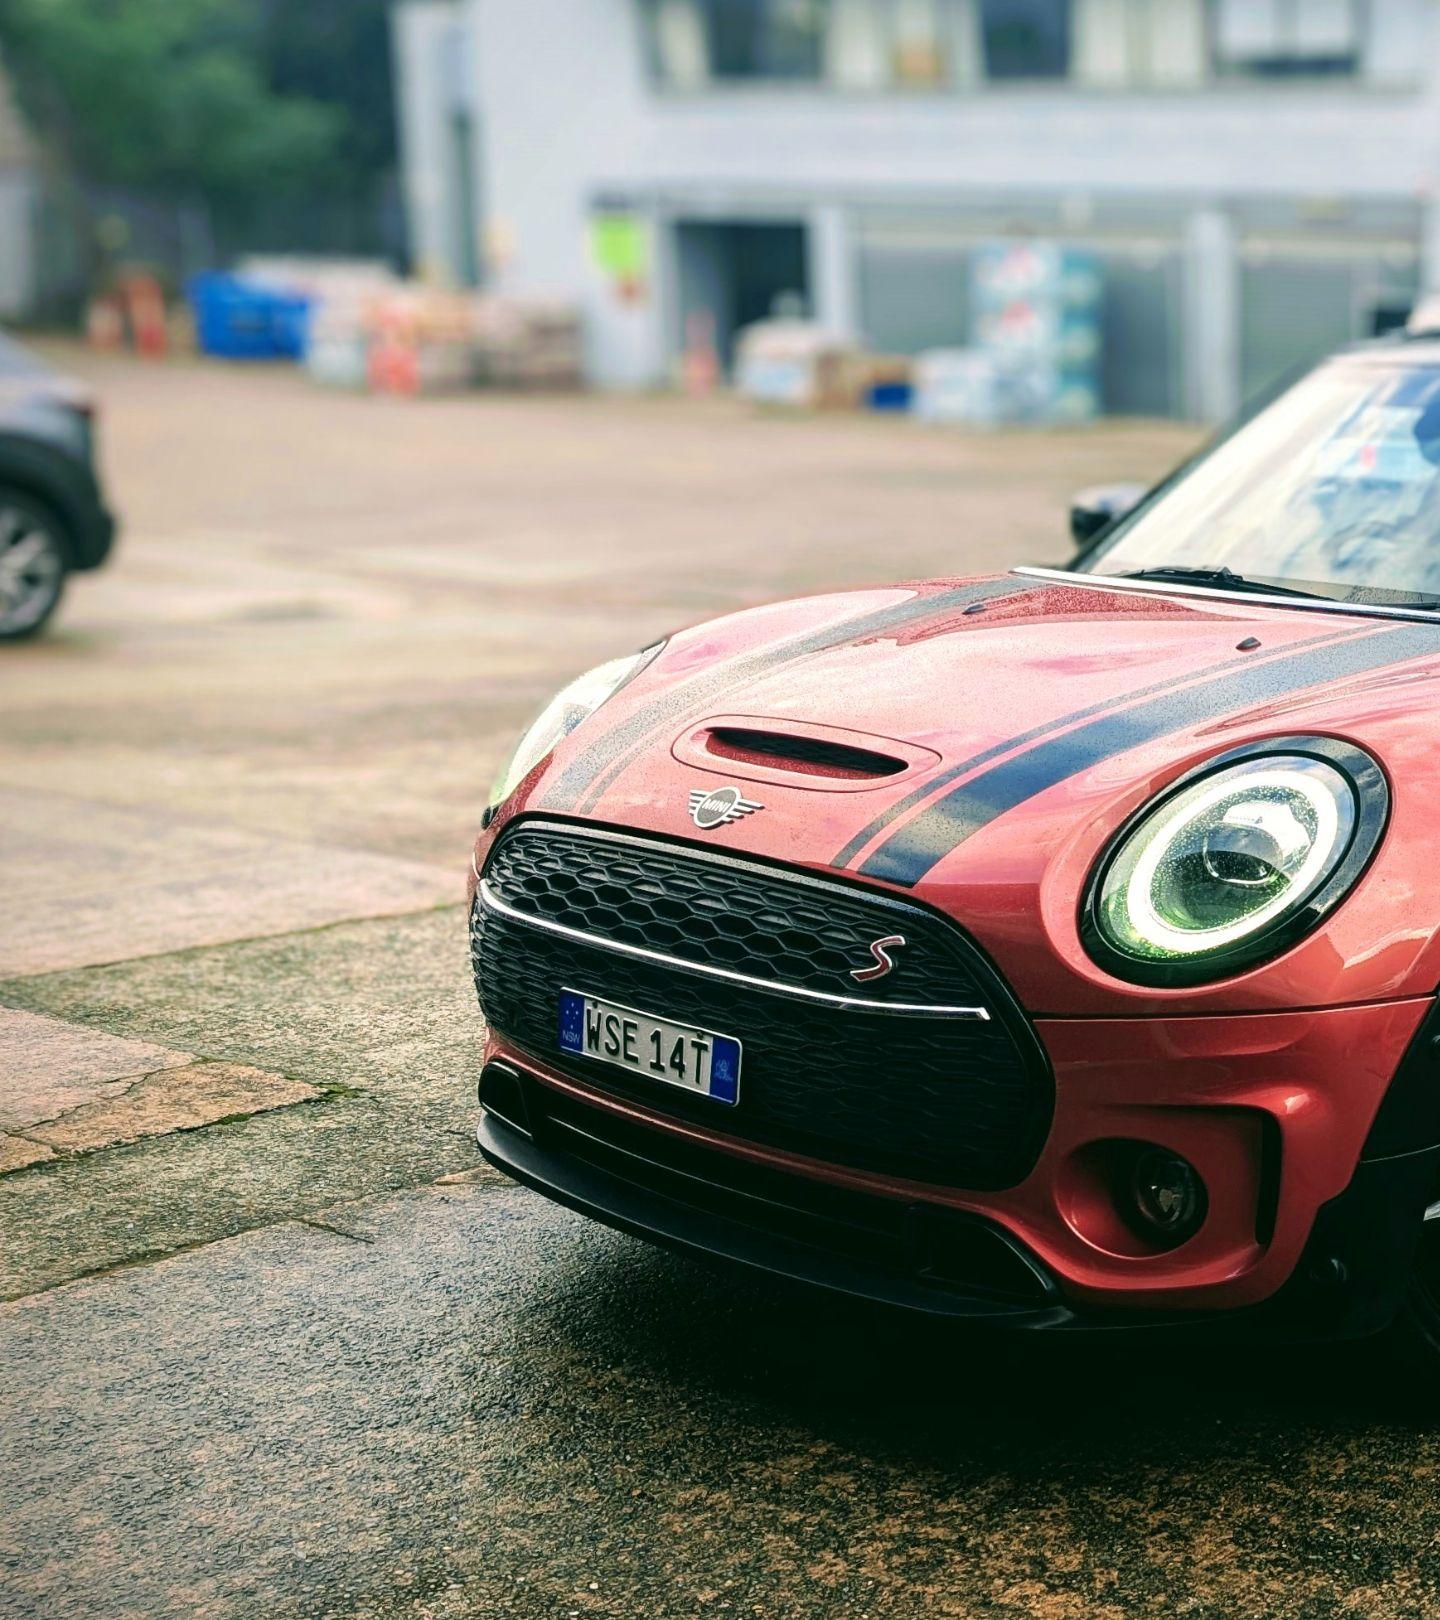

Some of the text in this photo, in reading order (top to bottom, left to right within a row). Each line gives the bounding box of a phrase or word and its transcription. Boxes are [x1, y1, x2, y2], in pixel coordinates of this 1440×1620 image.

[701, 798, 732, 814] MINI
[849, 935, 906, 982] S
[562, 1030, 580, 1045] NSW
[586, 1006, 709, 1084] WSE 14T
